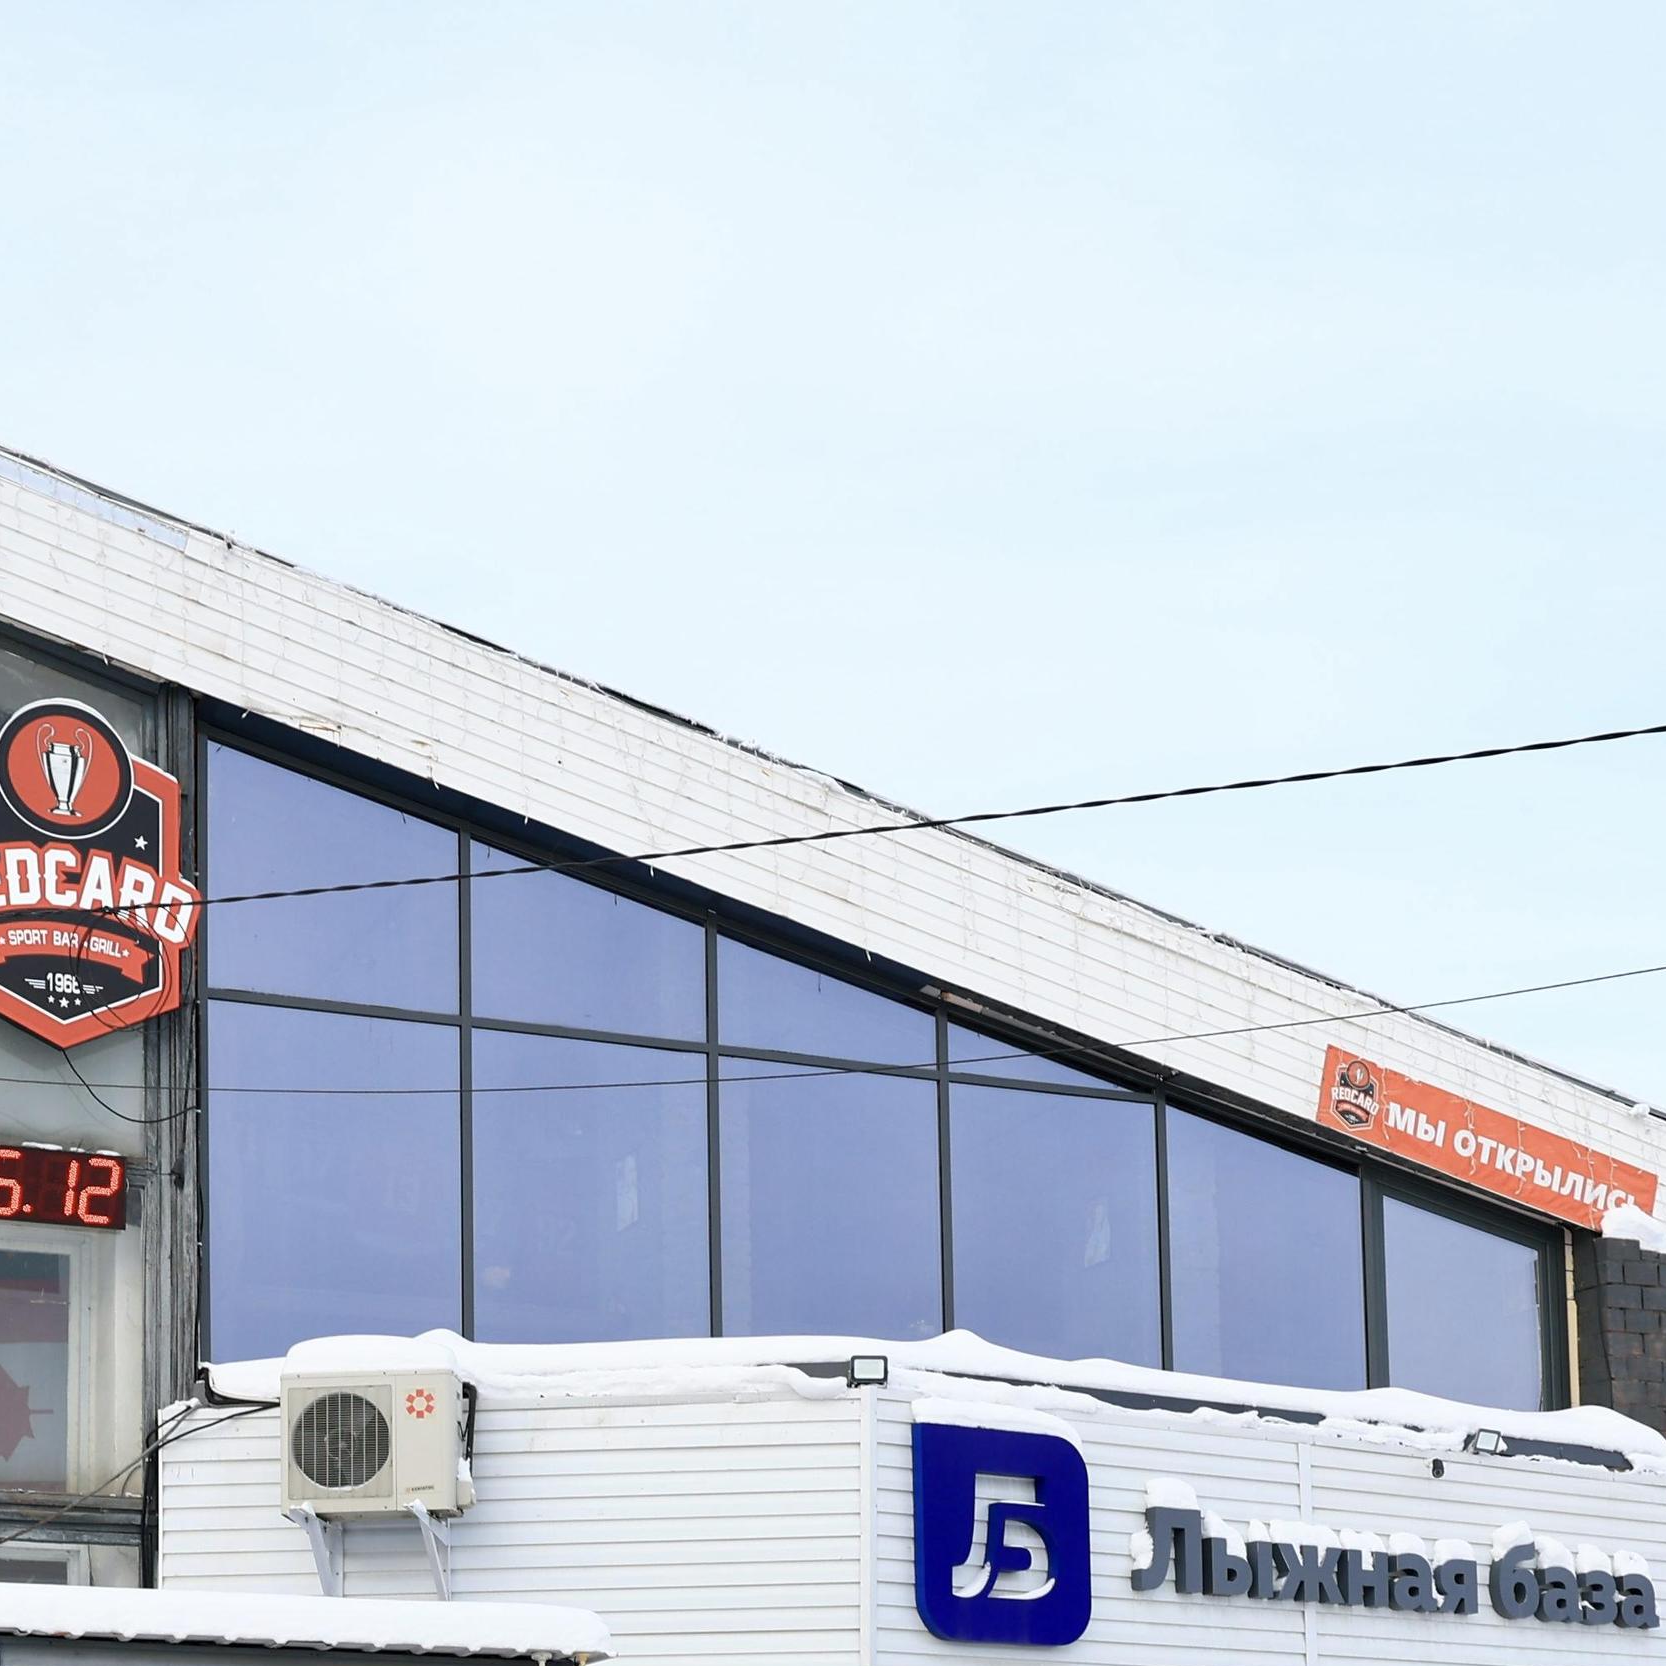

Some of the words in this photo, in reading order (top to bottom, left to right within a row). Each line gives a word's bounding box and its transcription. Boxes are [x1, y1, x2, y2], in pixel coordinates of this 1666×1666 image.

[7, 929, 48, 946] SPORT
[52, 930, 79, 949] BAR
[89, 936, 122, 958] GRILL
[1331, 1086, 1380, 1116] REDCARD
[1388, 1101, 1446, 1148] МЫ
[1131, 1506, 1479, 1616] Лыжная
[1489, 1541, 1662, 1630] база
